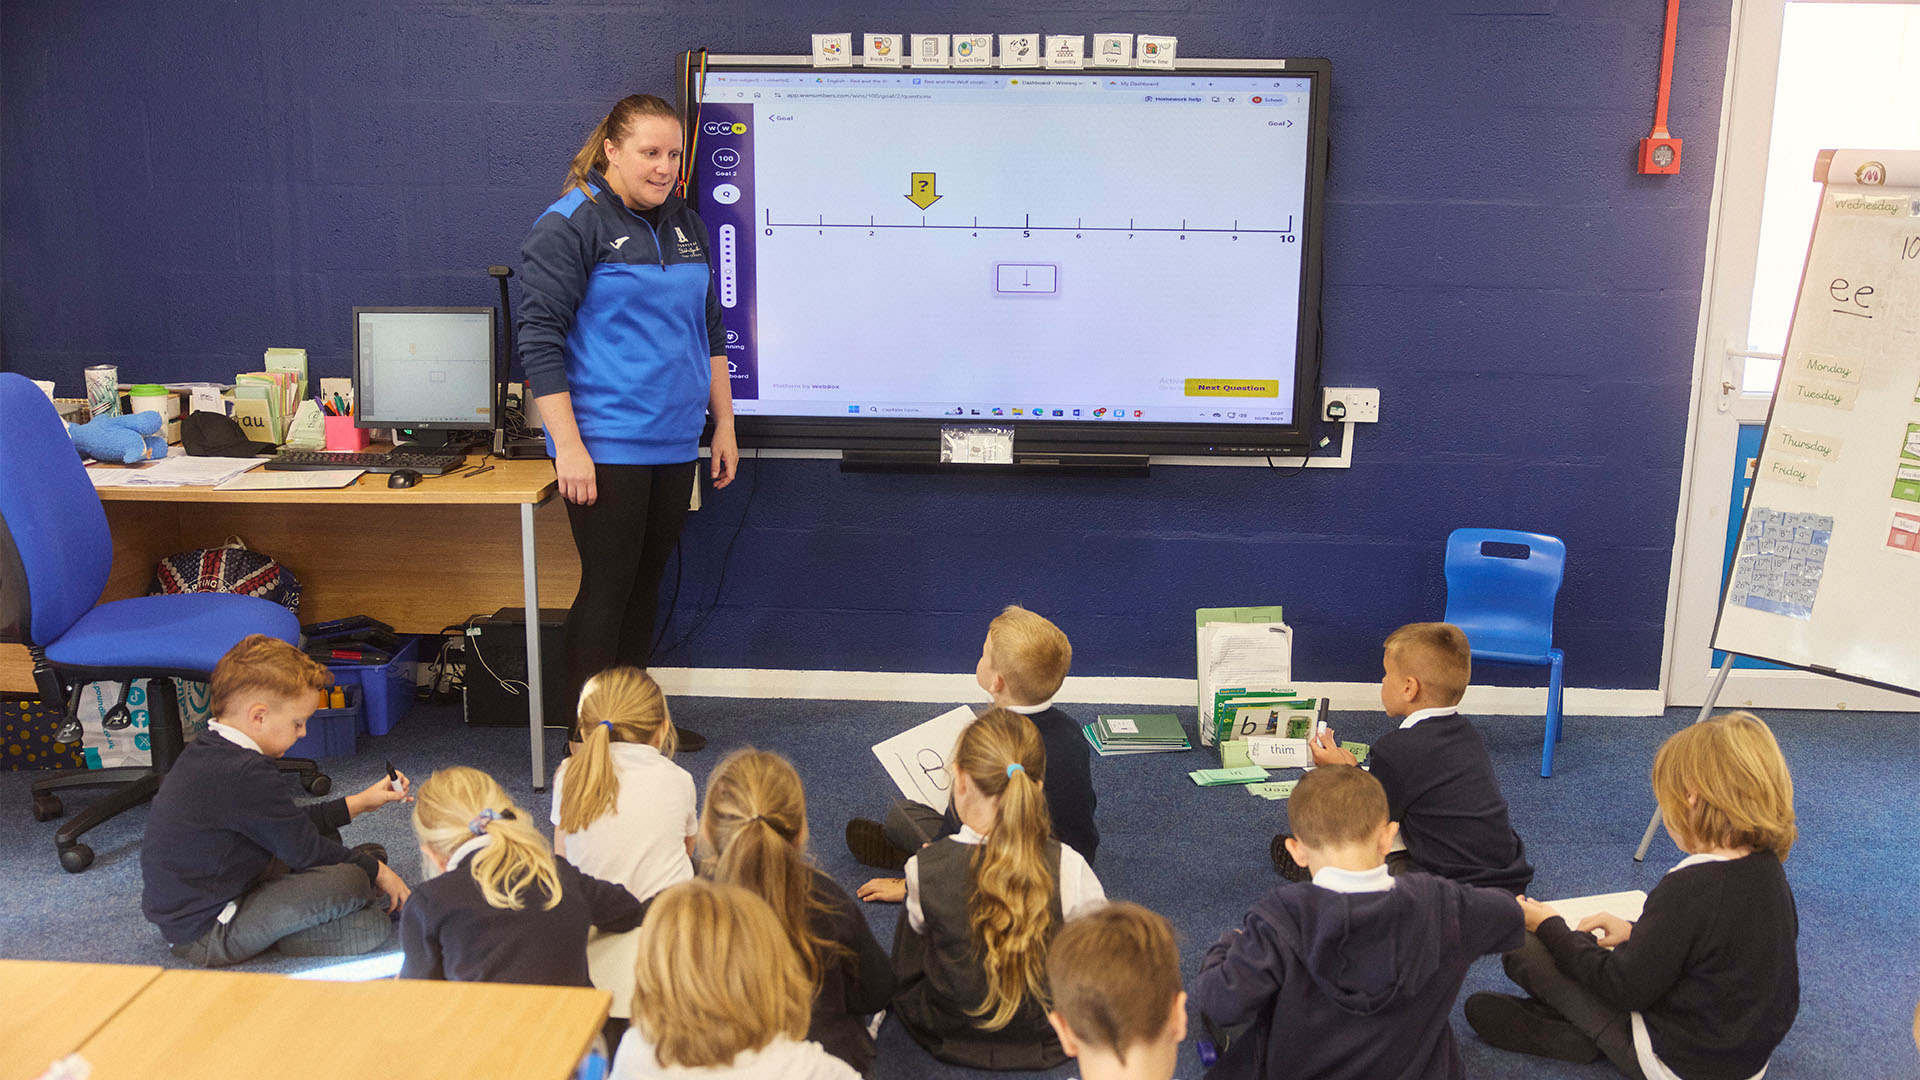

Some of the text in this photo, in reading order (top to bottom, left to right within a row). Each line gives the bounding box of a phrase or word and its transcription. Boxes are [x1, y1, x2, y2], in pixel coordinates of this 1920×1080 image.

[1835, 200, 1899, 215] Wednesday
[765, 228, 773, 237] 0
[1023, 230, 1030, 238] 5
[1280, 235, 1296, 243] 10
[1830, 278, 1874, 309] ee
[1806, 359, 1852, 378] Monday
[1798, 385, 1842, 405] Tuesday
[242, 415, 265, 428] au
[1782, 433, 1832, 456] Thursday
[1772, 463, 1808, 482] Friday
[1240, 715, 1257, 736] b
[1270, 743, 1296, 755] thim
